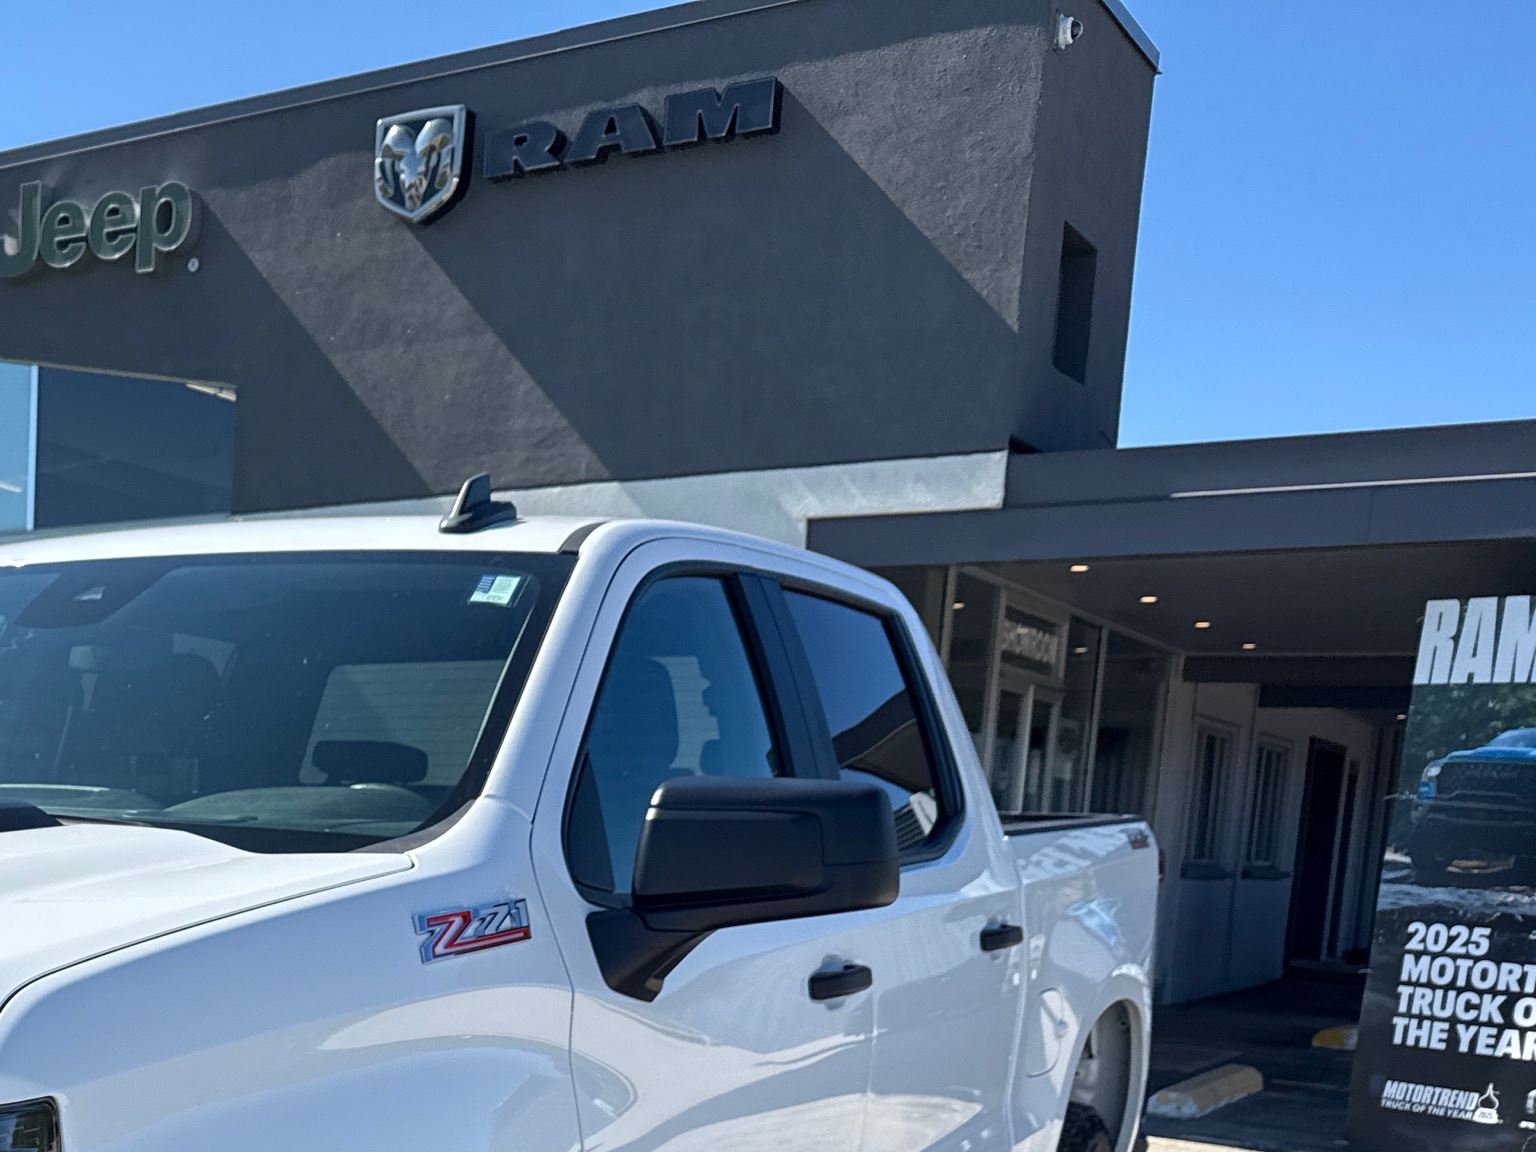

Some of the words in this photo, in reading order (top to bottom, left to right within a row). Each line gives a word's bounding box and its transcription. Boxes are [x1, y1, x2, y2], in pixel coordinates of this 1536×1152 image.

[483, 76, 778, 178] RAM
[1414, 595, 1536, 685] RAM
[413, 899, 531, 964] Z71
[1405, 921, 1492, 957] 2025
[1396, 985, 1507, 1025] TRUCK
[1392, 1016, 1450, 1051] THE
[1456, 1023, 1536, 1062] YEAR
[1380, 1098, 1412, 1111] TRUCK
[1412, 1104, 1426, 1113] OF
[1427, 1106, 1446, 1117] THE
[1447, 1108, 1473, 1120] YEAR
[1382, 1080, 1480, 1111] MOTORTREND
